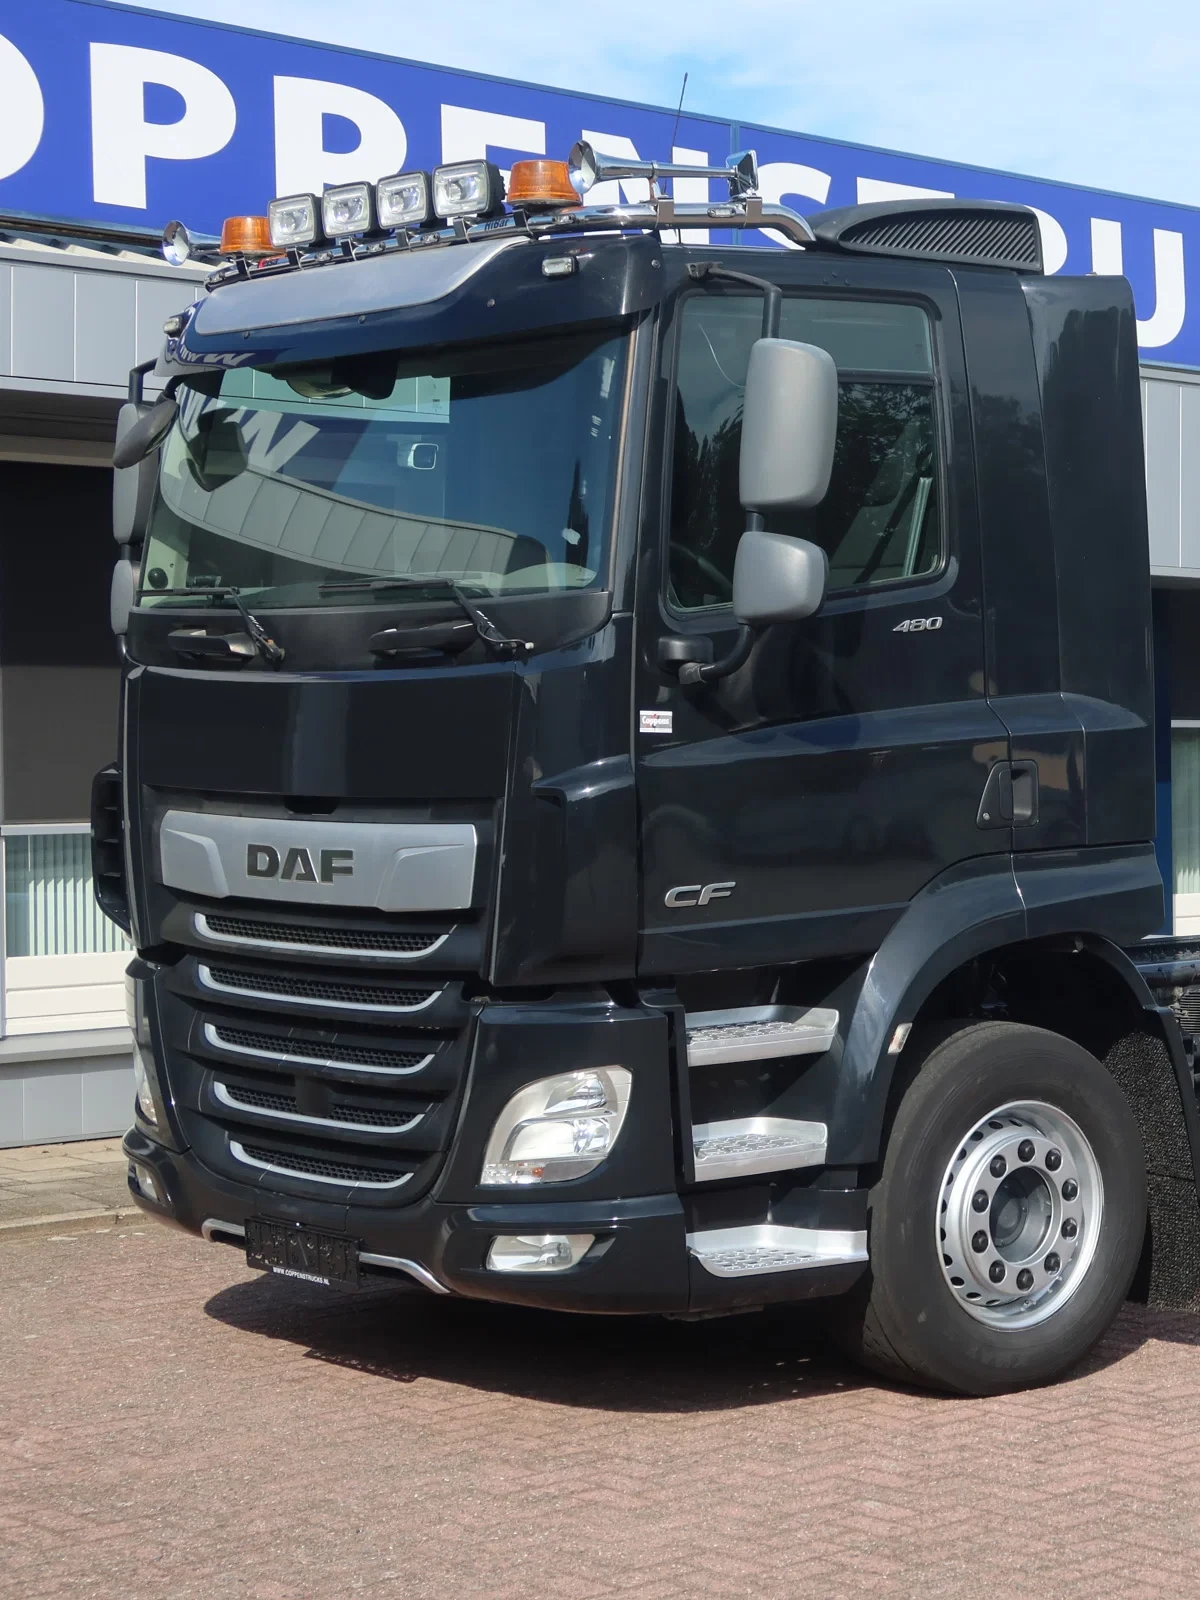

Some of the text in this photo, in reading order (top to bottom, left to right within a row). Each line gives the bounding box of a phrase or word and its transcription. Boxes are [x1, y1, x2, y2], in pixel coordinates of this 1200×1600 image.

[892, 616, 943, 633] 480
[641, 715, 670, 728] Coppens
[246, 843, 354, 884] DAF
[664, 881, 736, 908] CF
